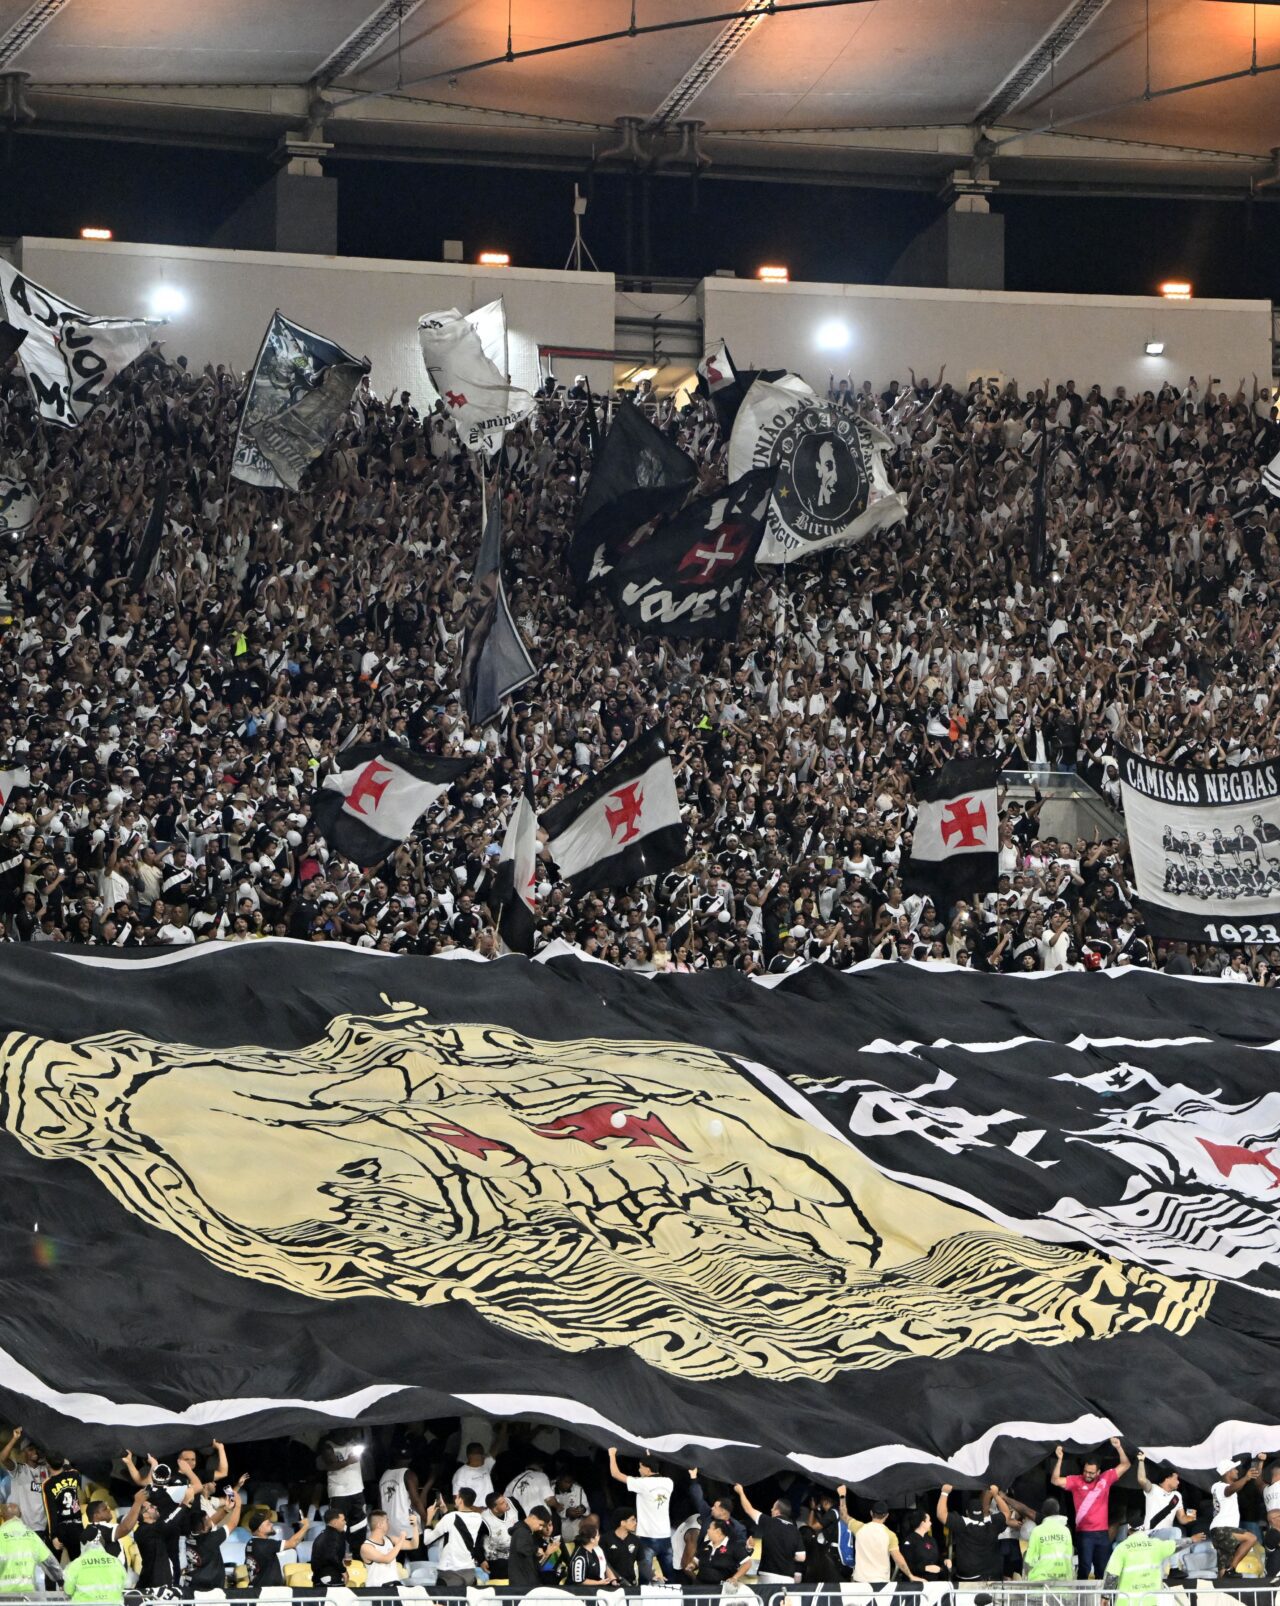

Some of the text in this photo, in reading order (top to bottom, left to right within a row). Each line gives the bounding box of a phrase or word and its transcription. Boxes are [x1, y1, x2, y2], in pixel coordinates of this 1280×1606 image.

[753, 413, 788, 470] UNIÃO
[1126, 758, 1278, 802] CAMISAS NEGRAS
[1203, 923, 1280, 944] 1923
[51, 1477, 77, 1496] RASTA
[82, 1557, 115, 1566] SUNSET
